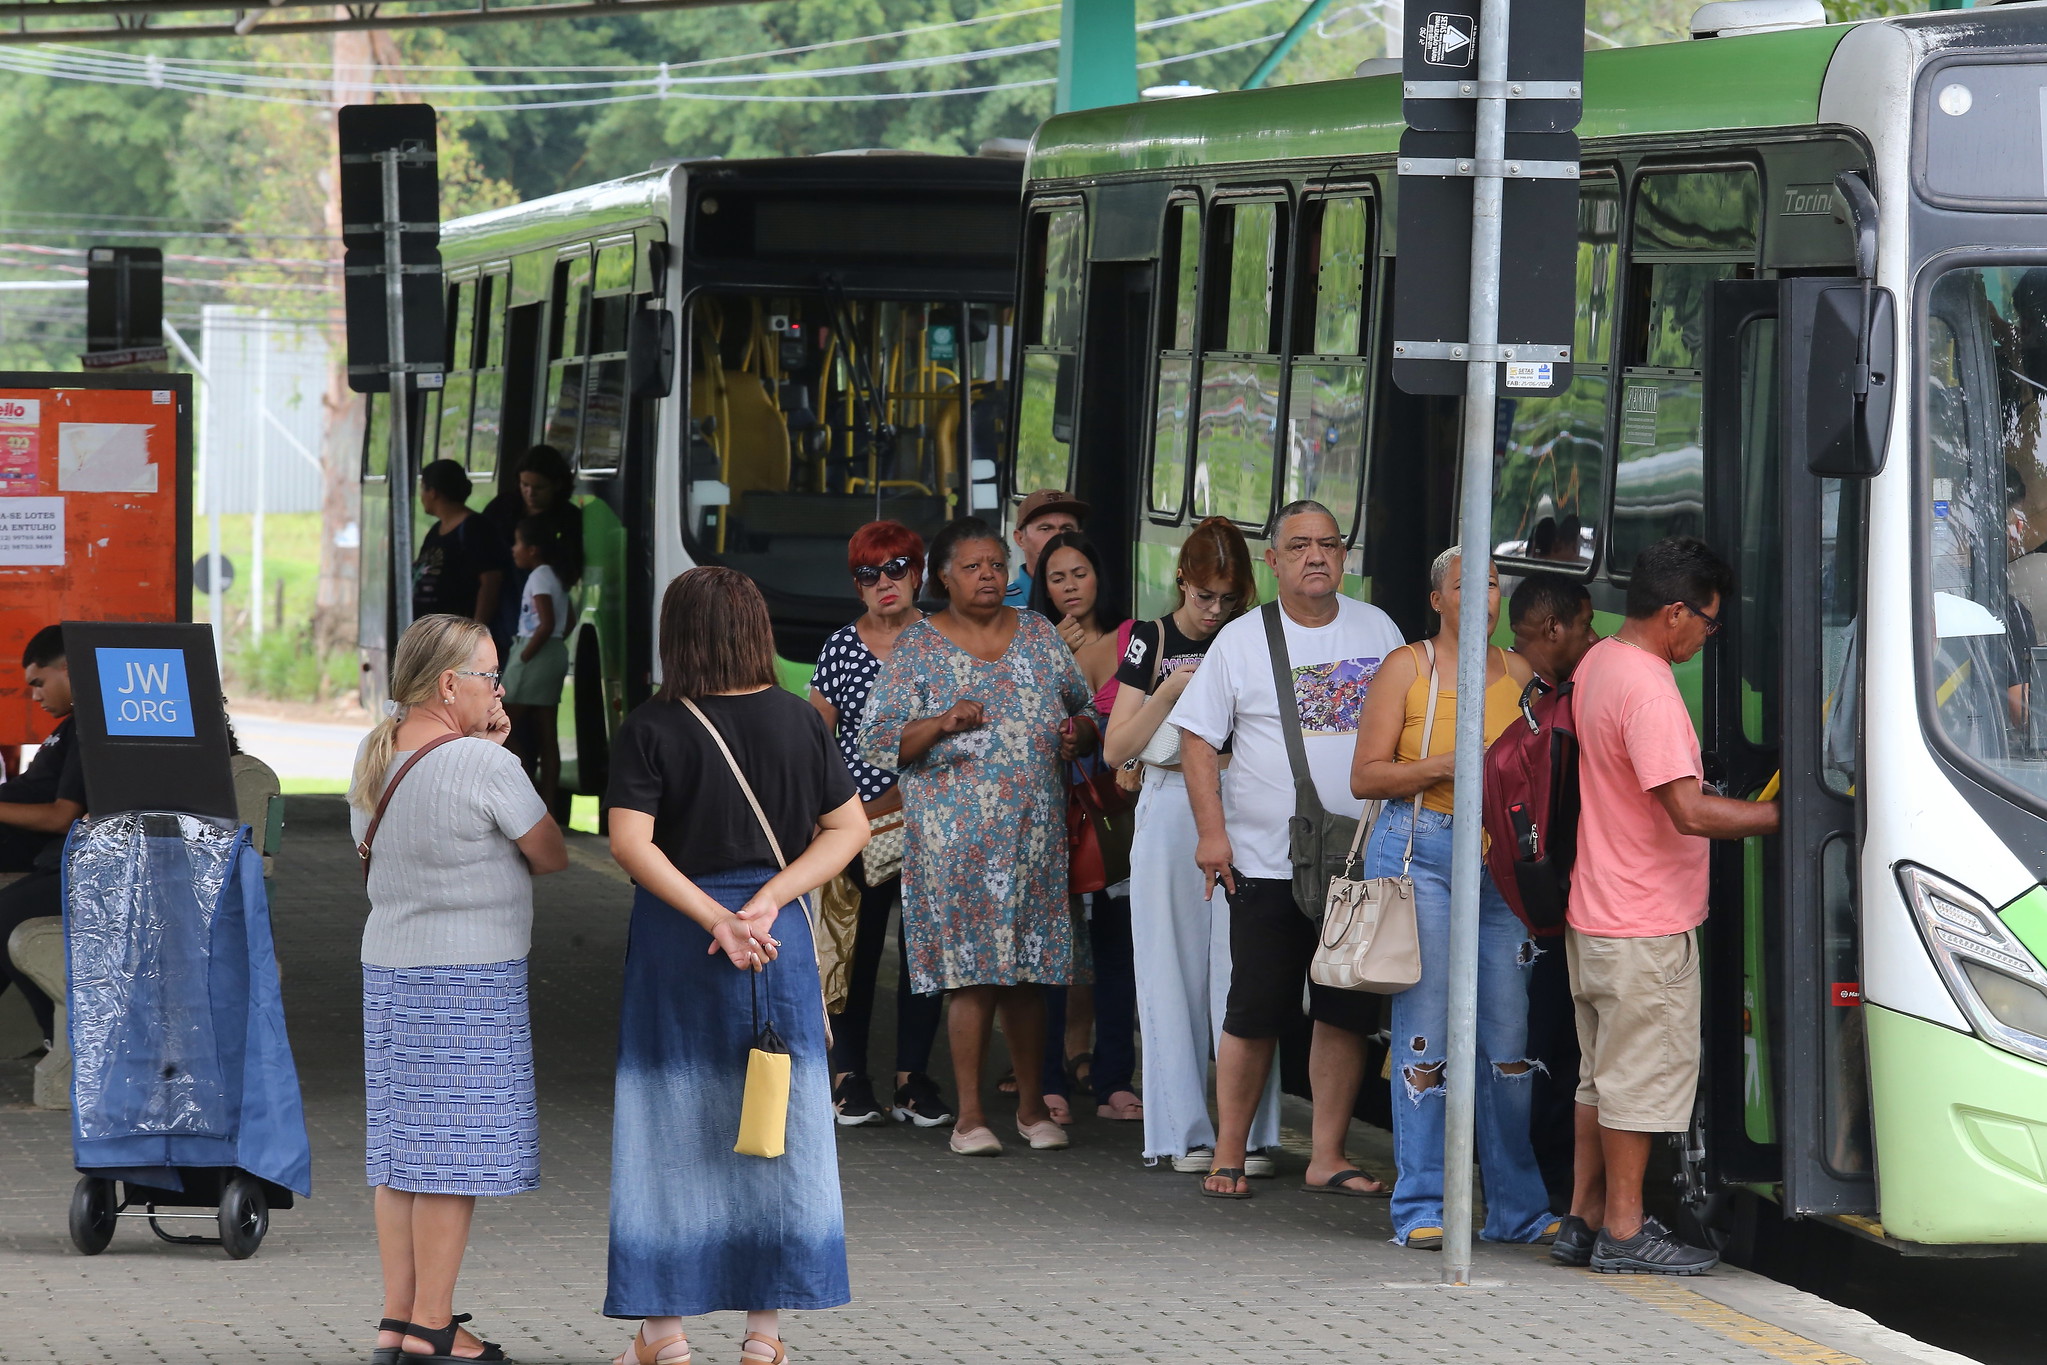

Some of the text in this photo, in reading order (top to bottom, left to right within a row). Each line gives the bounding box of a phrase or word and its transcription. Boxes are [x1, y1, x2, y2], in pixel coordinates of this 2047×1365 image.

[1785, 188, 1833, 212] Torin
[118, 662, 169, 694] JW
[117, 699, 177, 723] .ORG
